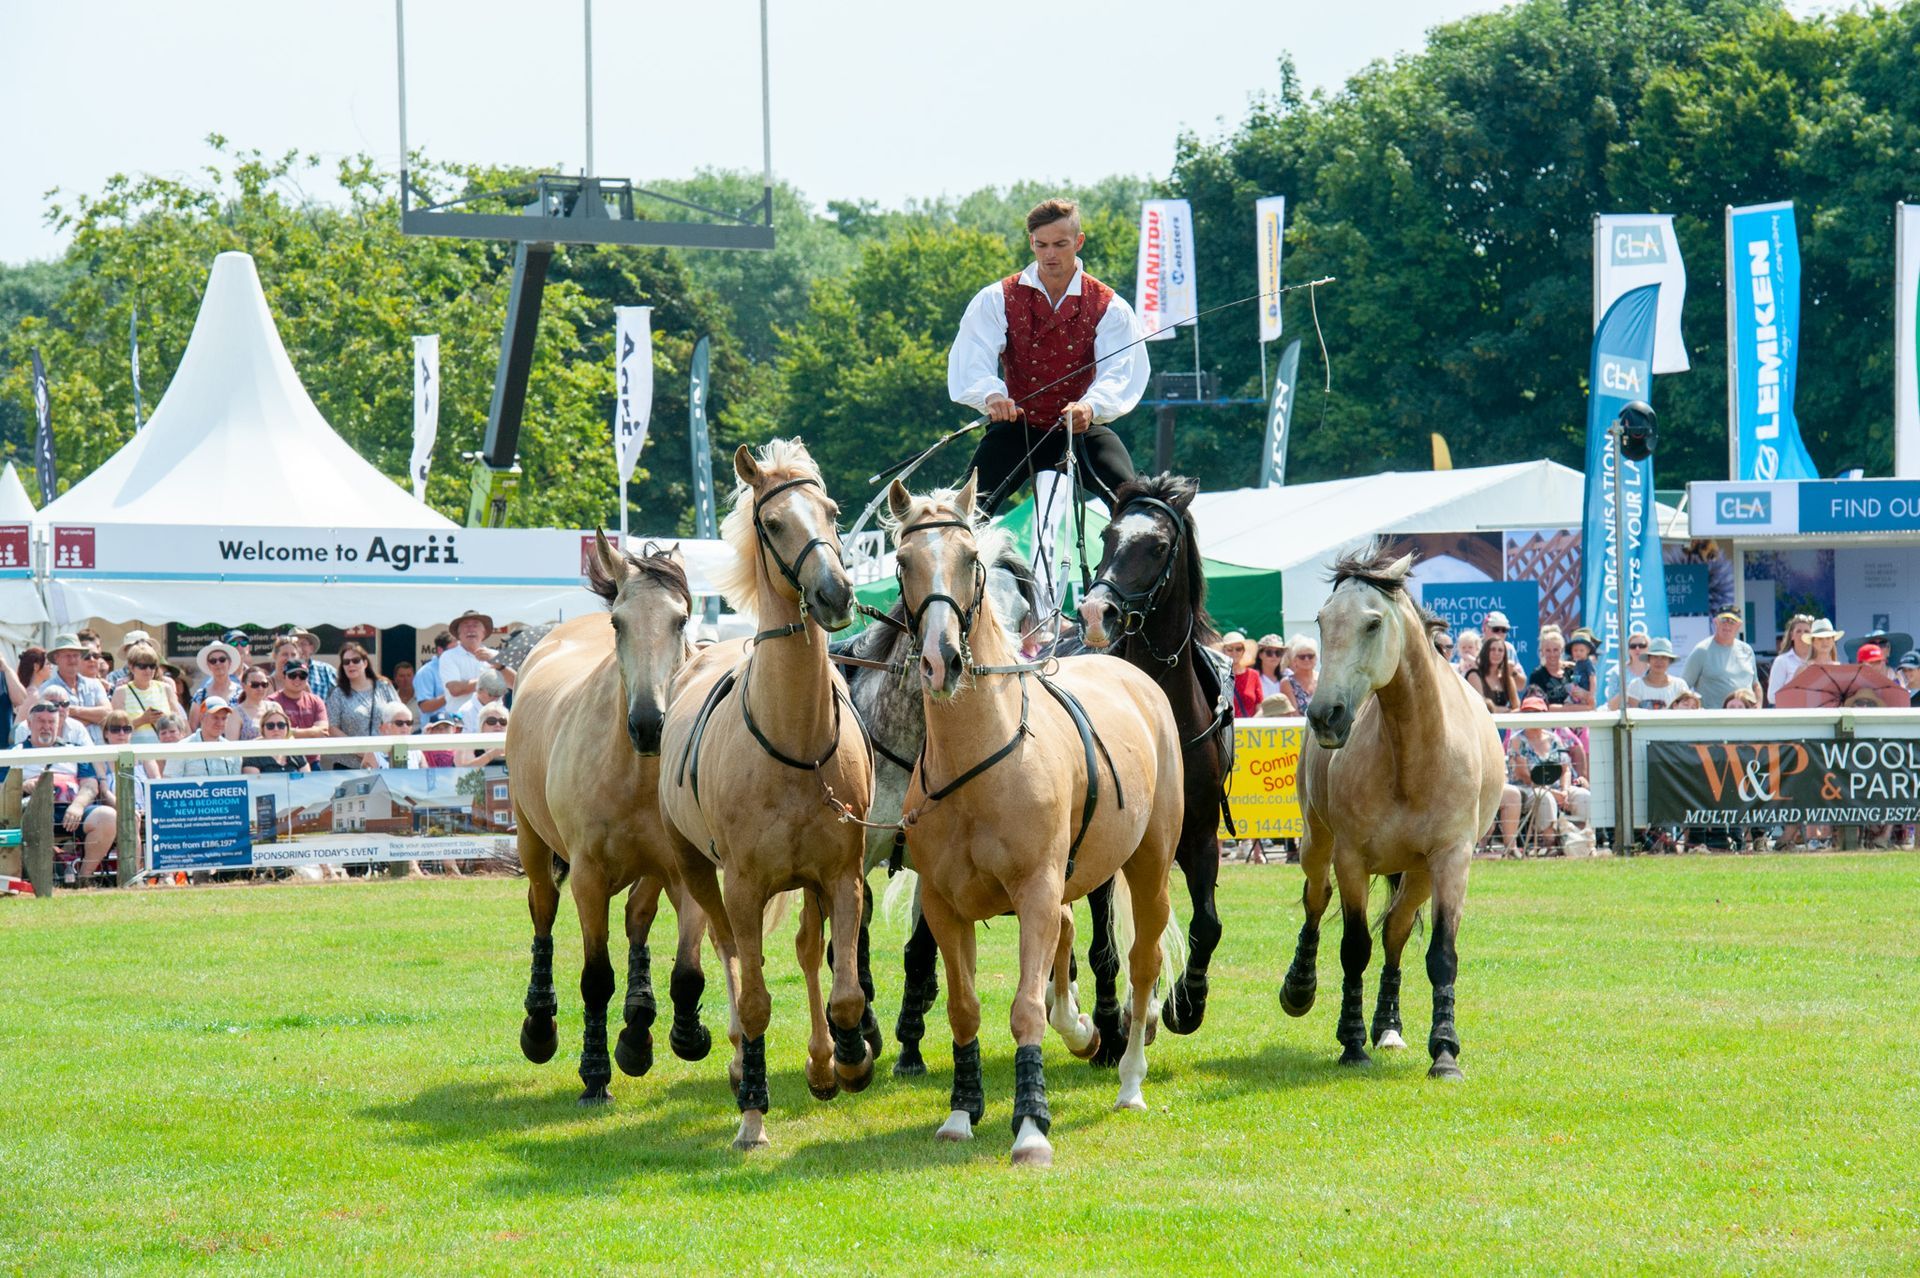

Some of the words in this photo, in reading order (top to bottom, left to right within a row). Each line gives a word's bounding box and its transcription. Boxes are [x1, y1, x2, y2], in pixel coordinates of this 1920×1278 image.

[1615, 232, 1660, 259] CLA
[1144, 210, 1160, 312] MANITOU
[1748, 239, 1780, 440] LEMKEN
[1602, 361, 1641, 393] CLA
[1721, 497, 1765, 519] CLA
[1831, 498, 1882, 518] FIND
[1603, 434, 1618, 606] ORGANISATION
[1627, 492, 1643, 551] YOUR
[218, 540, 329, 562] Welcome
[335, 544, 358, 561] to
[366, 535, 459, 571] Agrii
[1433, 596, 1506, 610] PRACTICAL
[155, 788, 209, 800] FARMSIDE
[211, 786, 247, 797] GREEN
[1263, 774, 1297, 792] Soo
[1820, 772, 1843, 800] &
[175, 808, 196, 816] NEW
[197, 806, 229, 815] HOMES
[195, 798, 240, 807] BEDROOM
[1684, 809, 1738, 824] MULTI
[1740, 808, 1802, 823] AWARD
[1805, 807, 1883, 823] WINNING
[160, 842, 180, 851] Prices
[182, 841, 200, 849] from
[253, 849, 313, 861] SPONSORING
[313, 847, 350, 858] TODAY'S
[351, 846, 379, 857] EVENT
